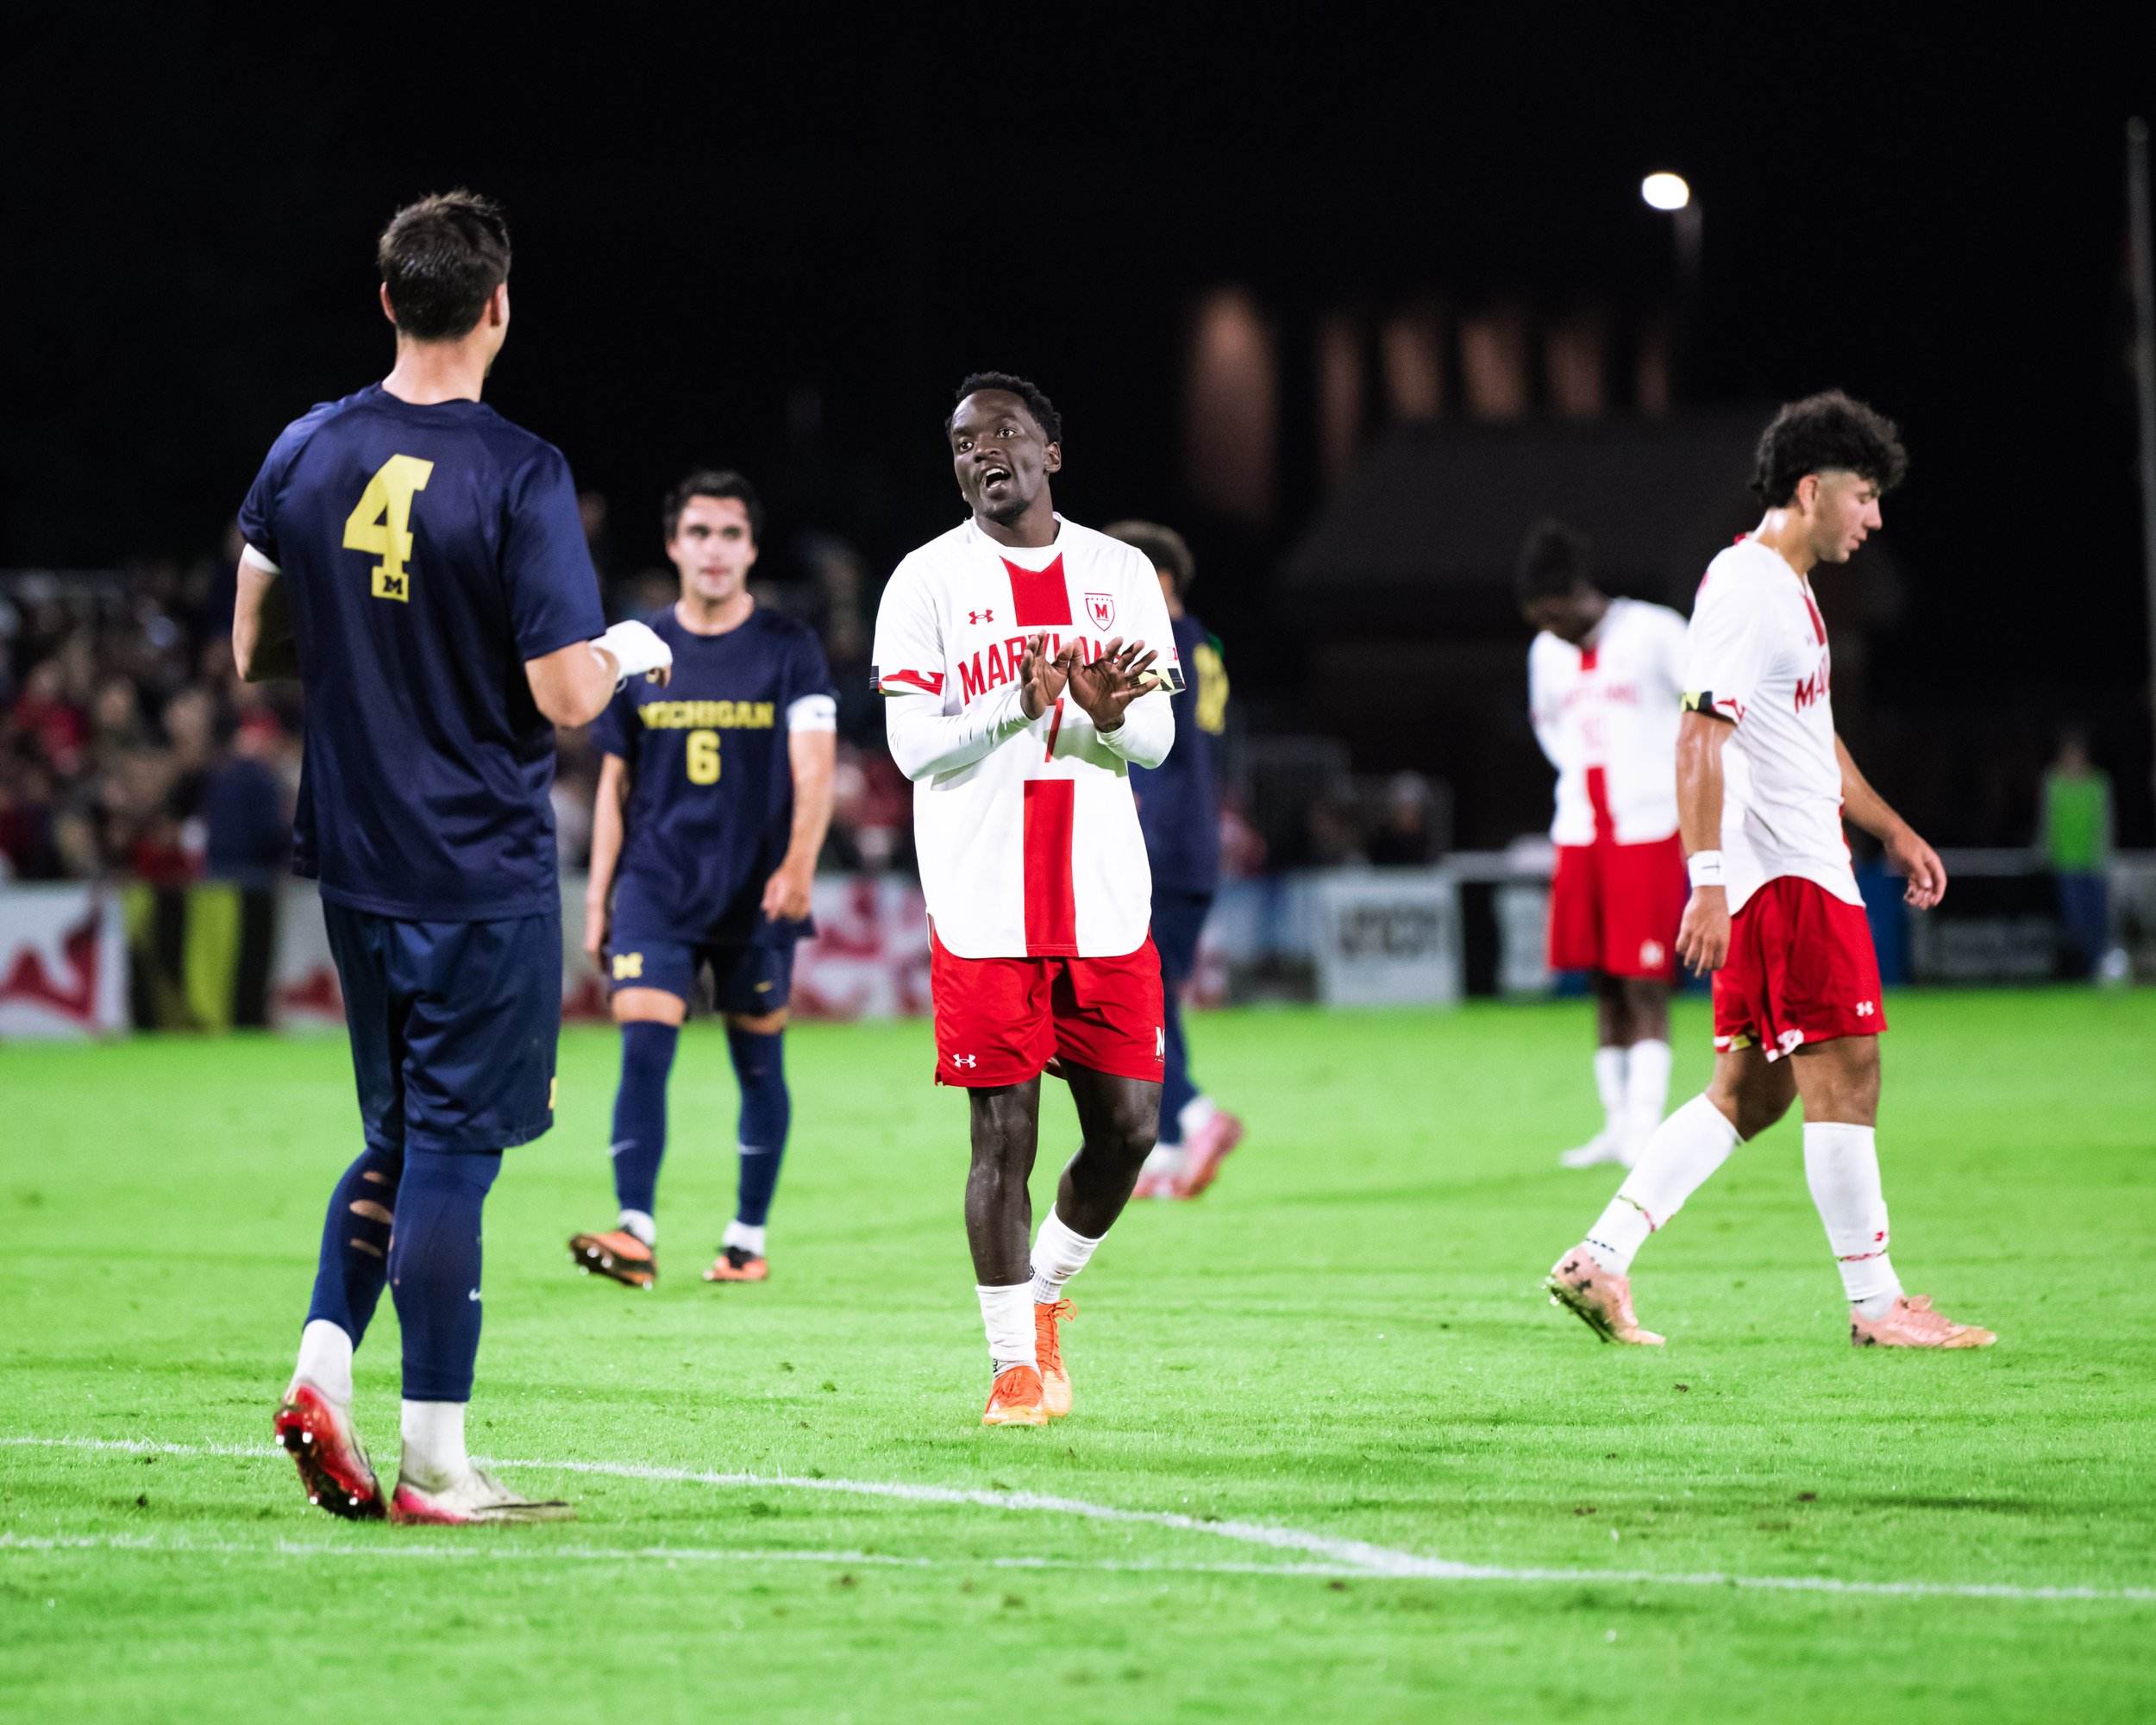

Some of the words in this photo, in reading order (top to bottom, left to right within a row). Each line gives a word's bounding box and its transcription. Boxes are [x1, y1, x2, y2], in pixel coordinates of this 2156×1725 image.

[342, 453, 435, 603] 4
[383, 574, 403, 595] M
[1094, 603, 1109, 619] M
[957, 632, 1123, 706] MARYL
[686, 728, 722, 786] 6
